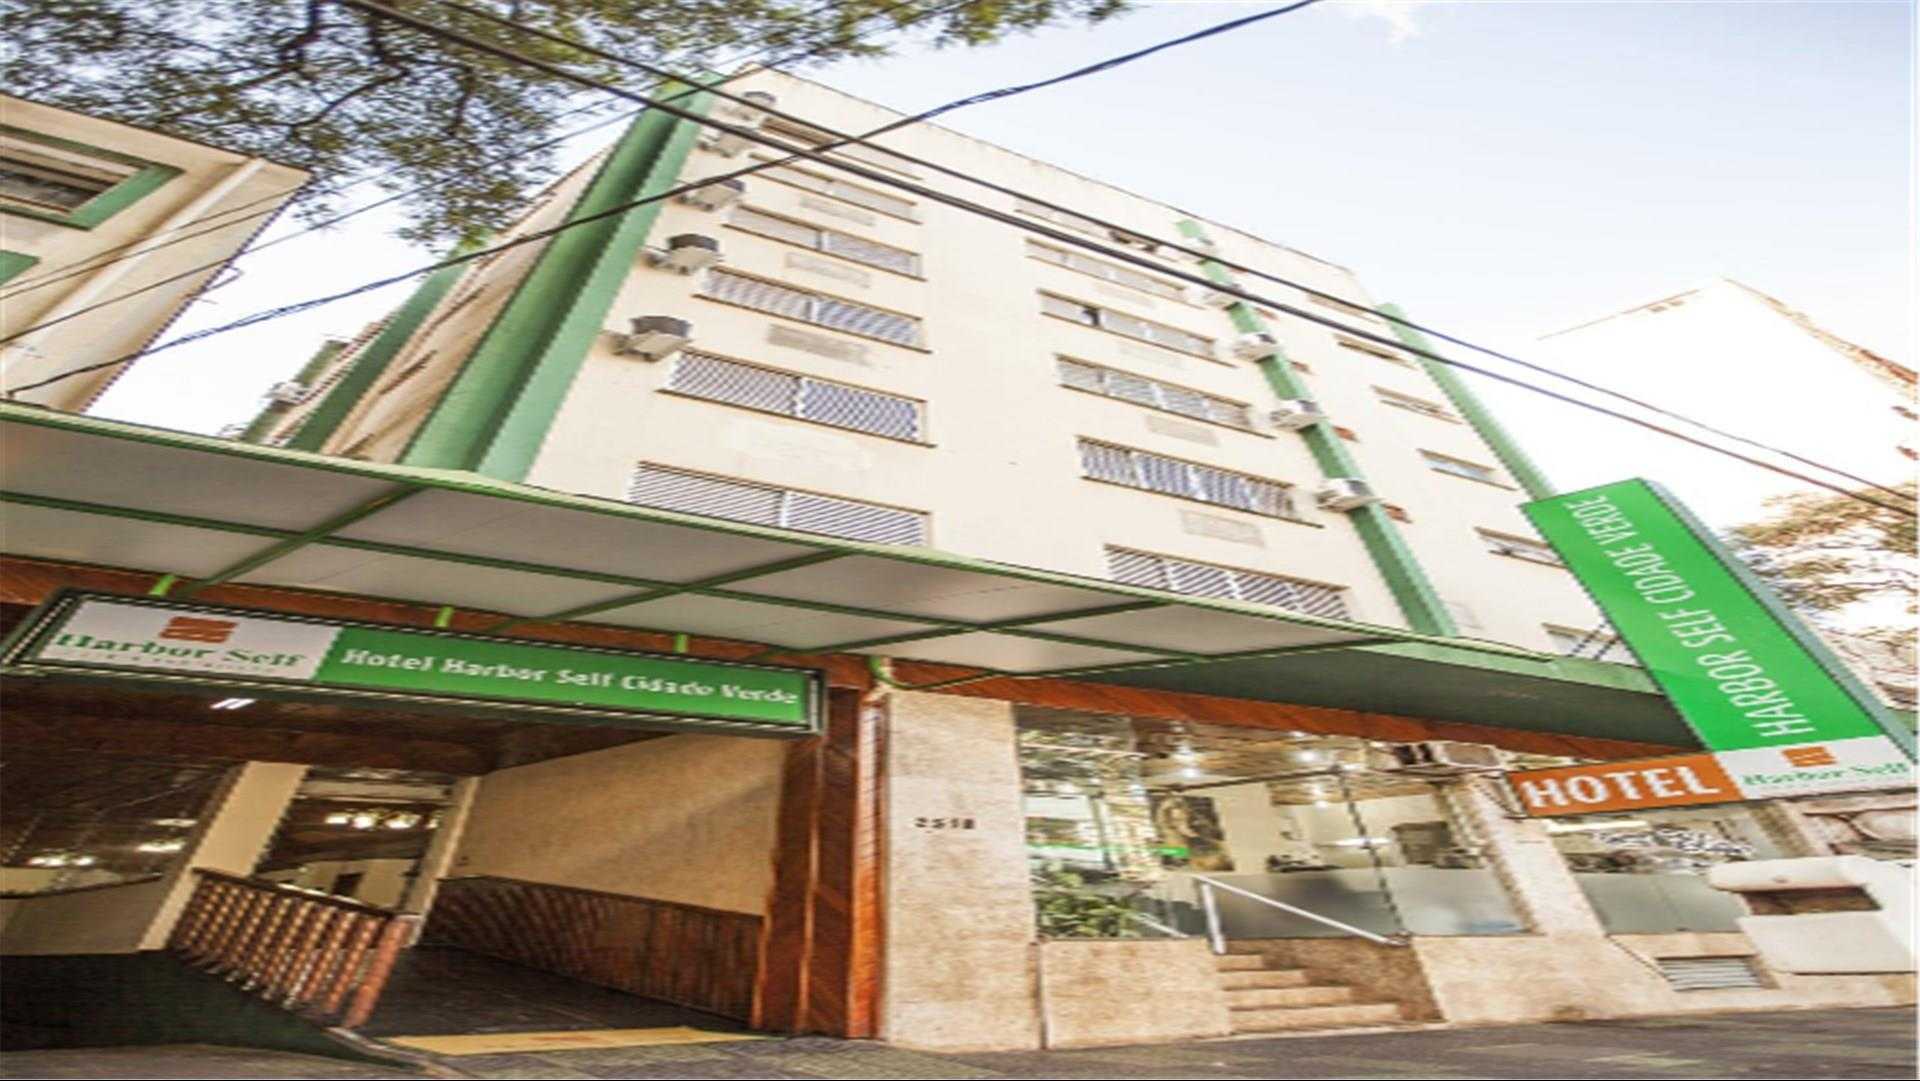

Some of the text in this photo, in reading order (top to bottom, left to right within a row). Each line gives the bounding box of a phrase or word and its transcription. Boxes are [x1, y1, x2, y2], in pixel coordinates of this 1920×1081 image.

[1562, 496, 1816, 738] HARBOR SELF CIDADE VERDE
[55, 633, 215, 660] Harbor
[222, 649, 307, 667] Self
[340, 648, 798, 704] Hotel Harbor Self Cidade Verde
[1520, 766, 1720, 808] HOTEL
